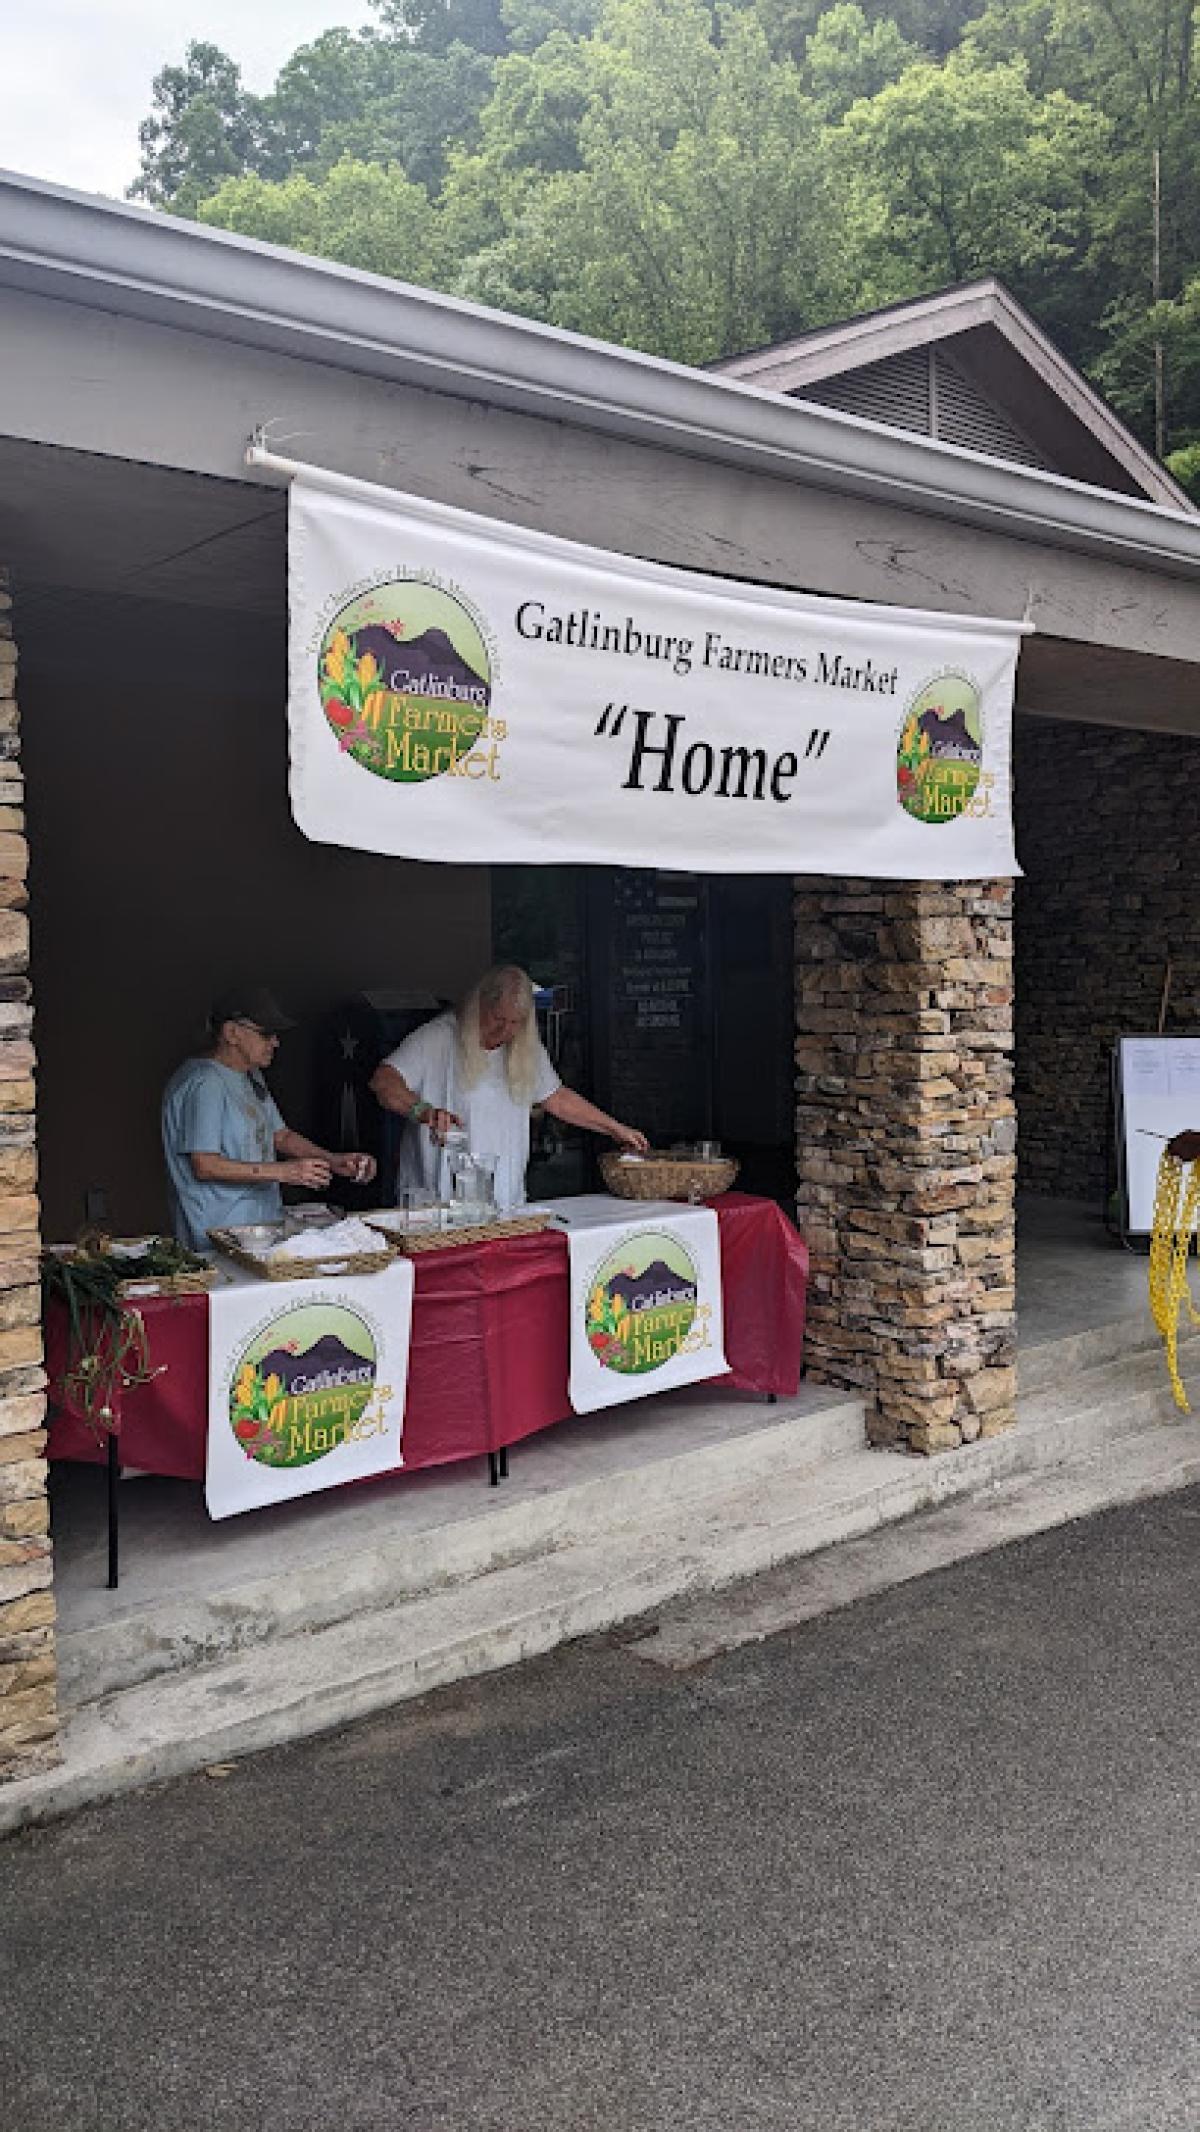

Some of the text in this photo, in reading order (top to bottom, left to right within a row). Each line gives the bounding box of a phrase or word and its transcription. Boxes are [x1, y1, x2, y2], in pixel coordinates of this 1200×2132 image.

[515, 601, 693, 676] Gatlinburg
[702, 632, 807, 681] Farmers
[814, 652, 898, 695] Market
[390, 669, 490, 710] Gatlinburg
[389, 696, 508, 739] Farmers
[385, 728, 501, 781] Market
[922, 783, 996, 818] Market
[631, 1319, 713, 1370] Market
[289, 1384, 395, 1426] Farmers
[287, 1404, 388, 1462] Market
